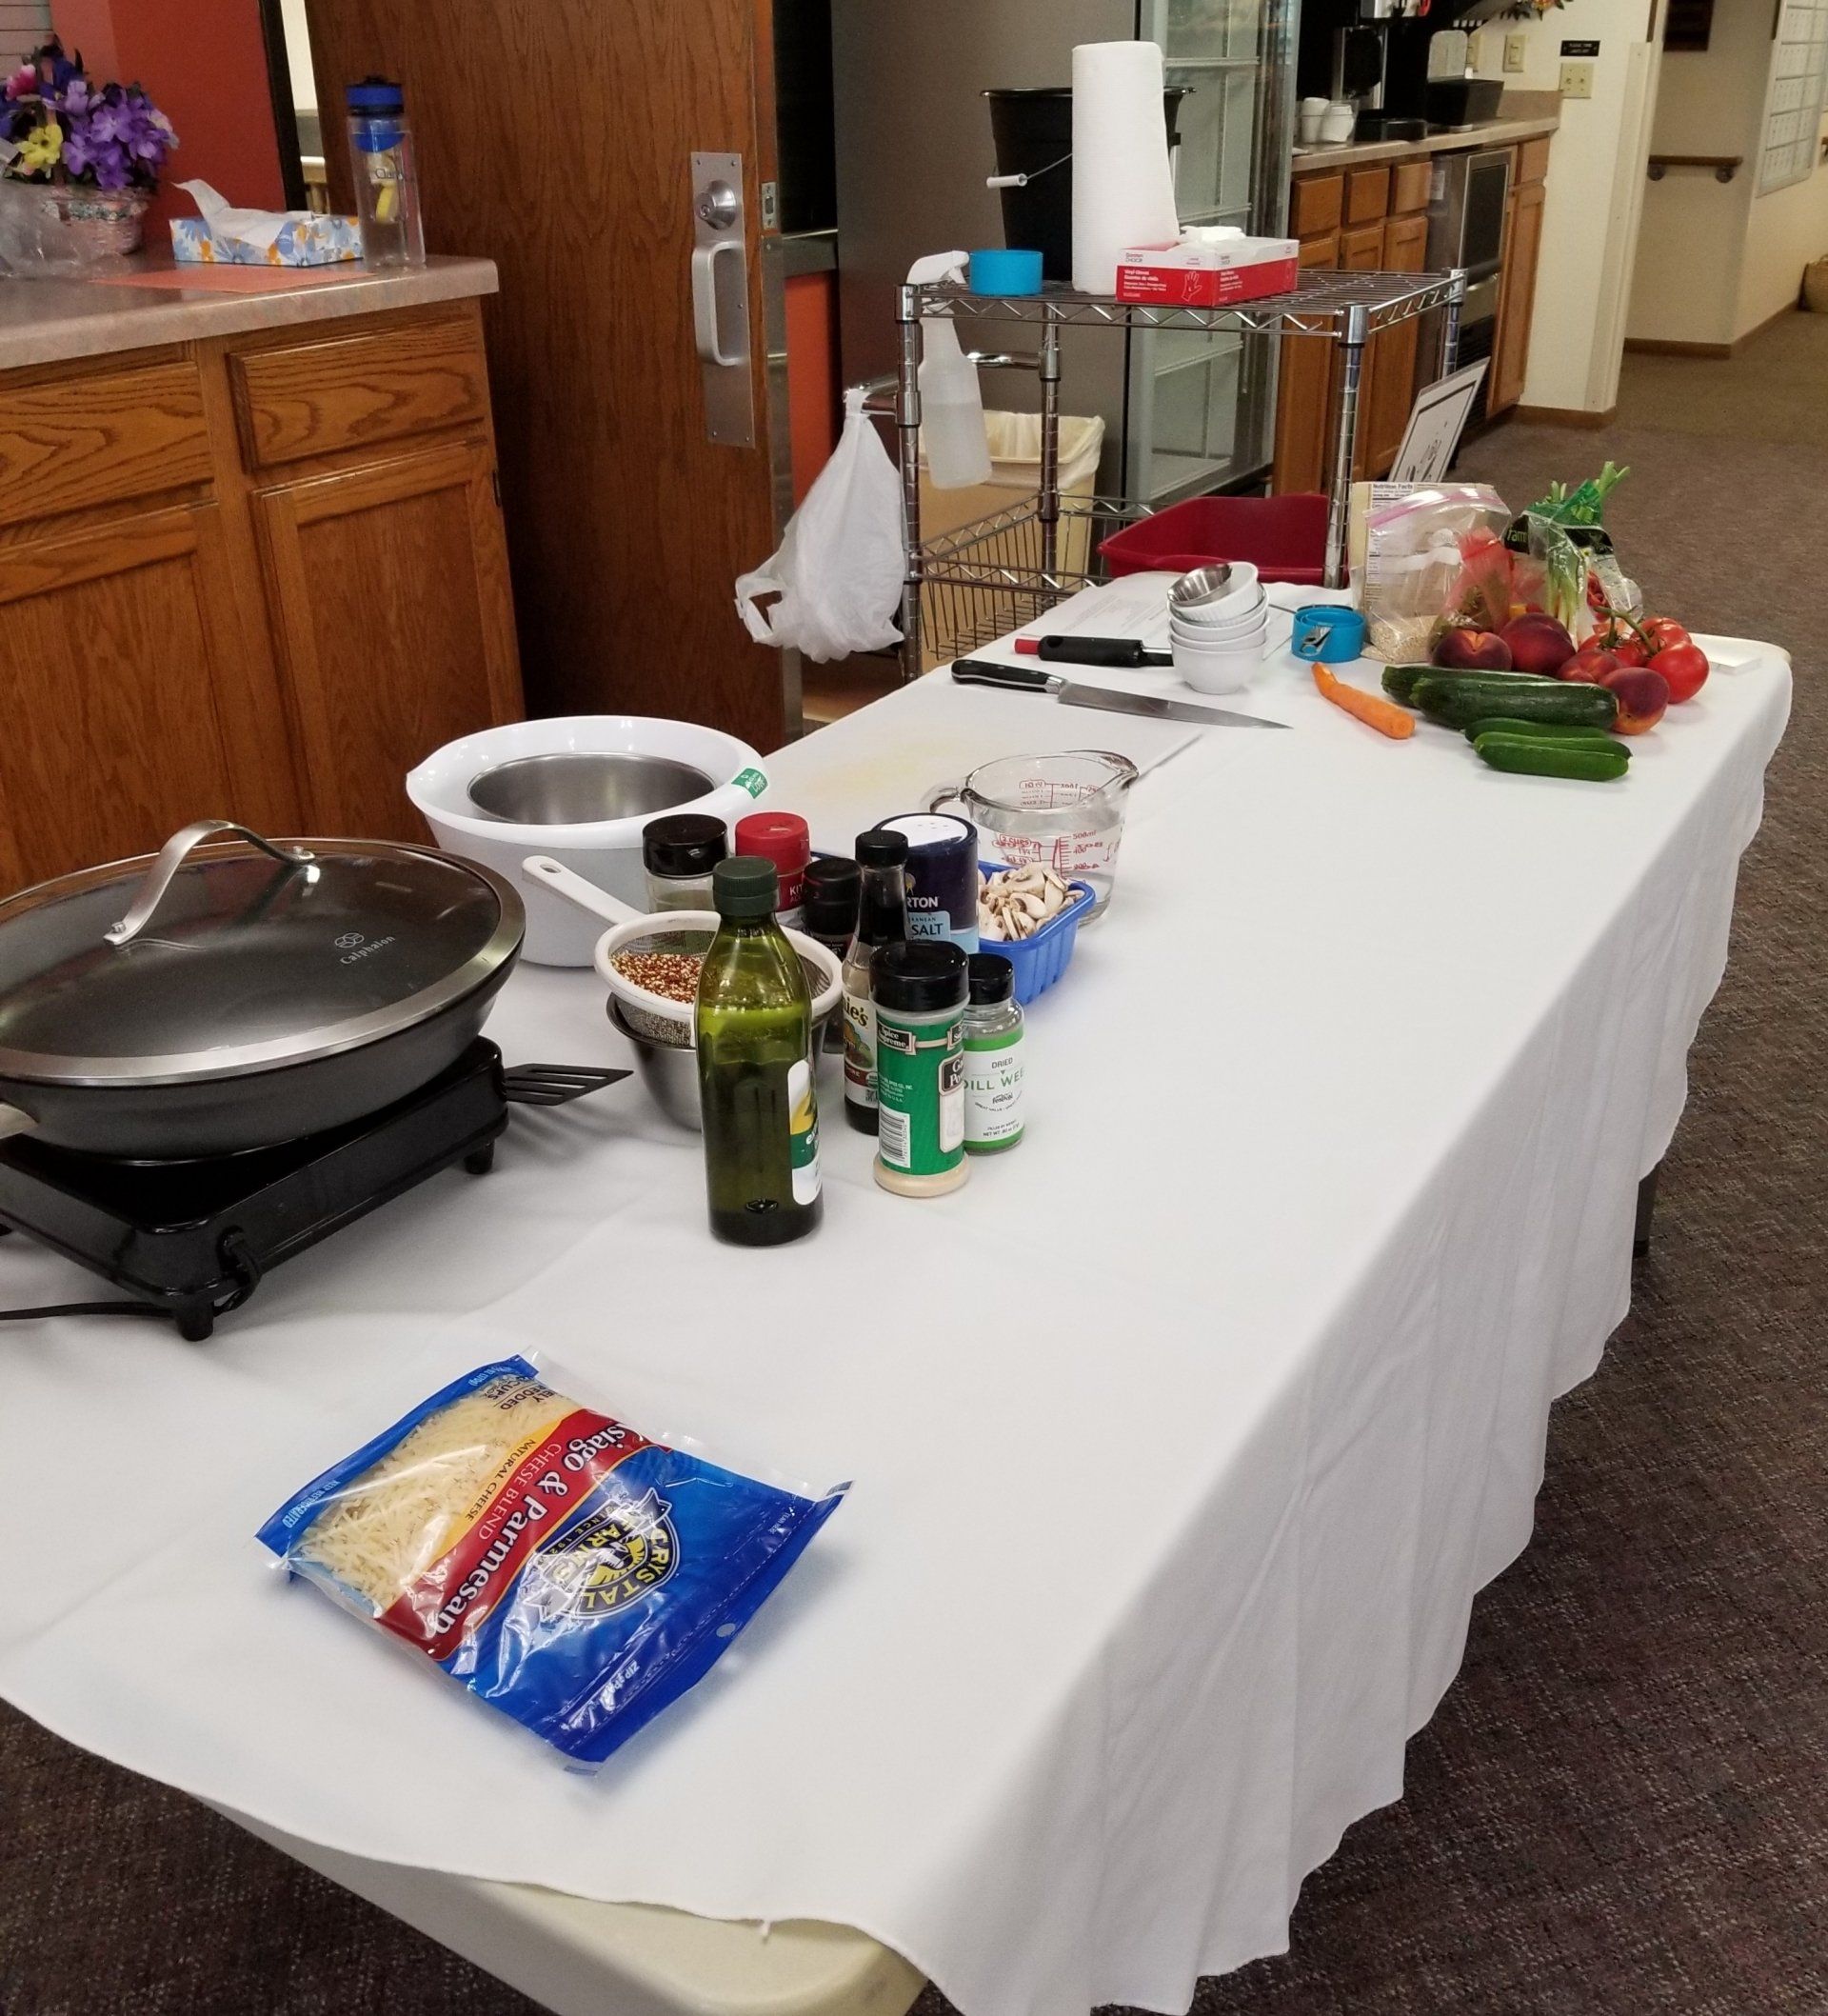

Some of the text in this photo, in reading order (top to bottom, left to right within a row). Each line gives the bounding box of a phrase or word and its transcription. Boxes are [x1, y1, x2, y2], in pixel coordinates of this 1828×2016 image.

[906, 896, 939, 908] RTON
[911, 923, 944, 936] SALT
[340, 936, 396, 964] Calphalon
[992, 1057, 1013, 1068] DRIED
[500, 1385, 545, 1411] REDDED
[467, 1439, 536, 1522] NATURAL CHEESE
[478, 1443, 562, 1541] CHEESE BLEND
[537, 1470, 569, 1497] &
[433, 1494, 547, 1635] Parmesan
[582, 1526, 670, 1609] CRYSTAL
